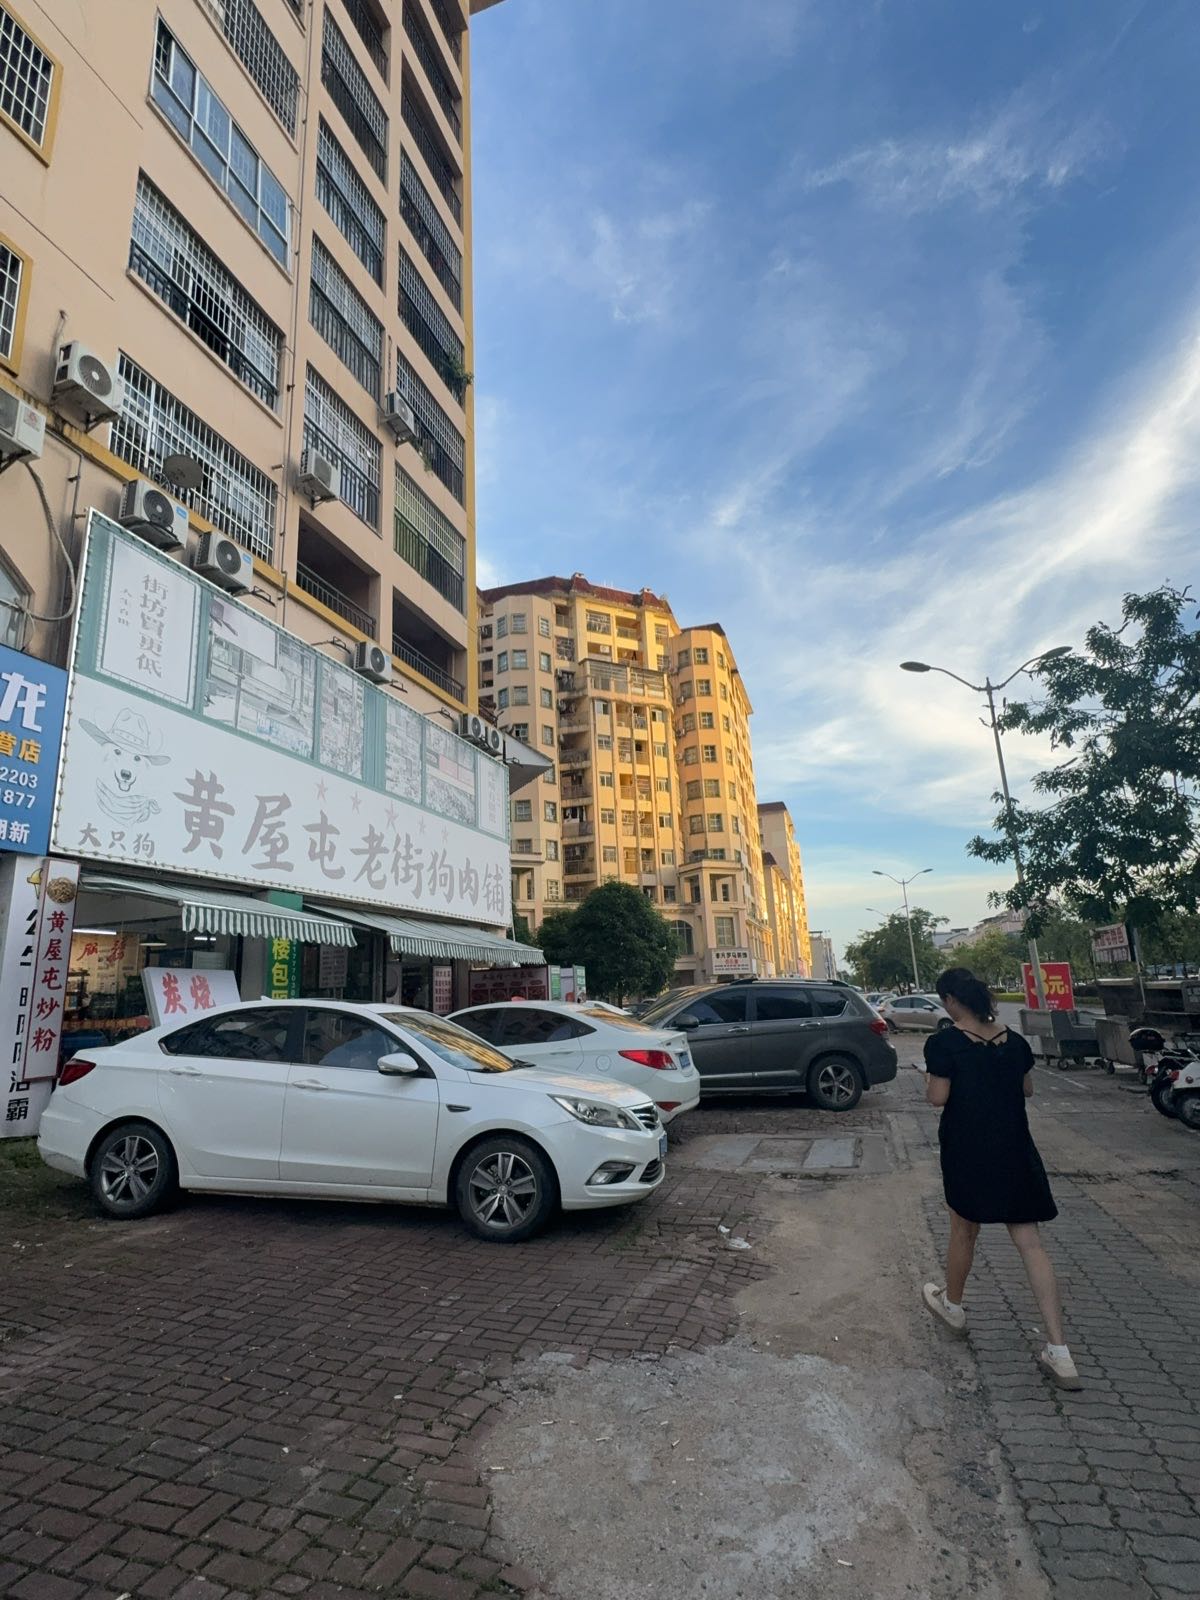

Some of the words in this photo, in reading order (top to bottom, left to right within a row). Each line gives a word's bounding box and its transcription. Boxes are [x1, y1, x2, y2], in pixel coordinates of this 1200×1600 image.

[78, 823, 155, 858] 大只狗
[172, 768, 504, 917] 黄屋屯老街狗肉铺
[31, 910, 69, 1053] 黄屋屯炒粉
